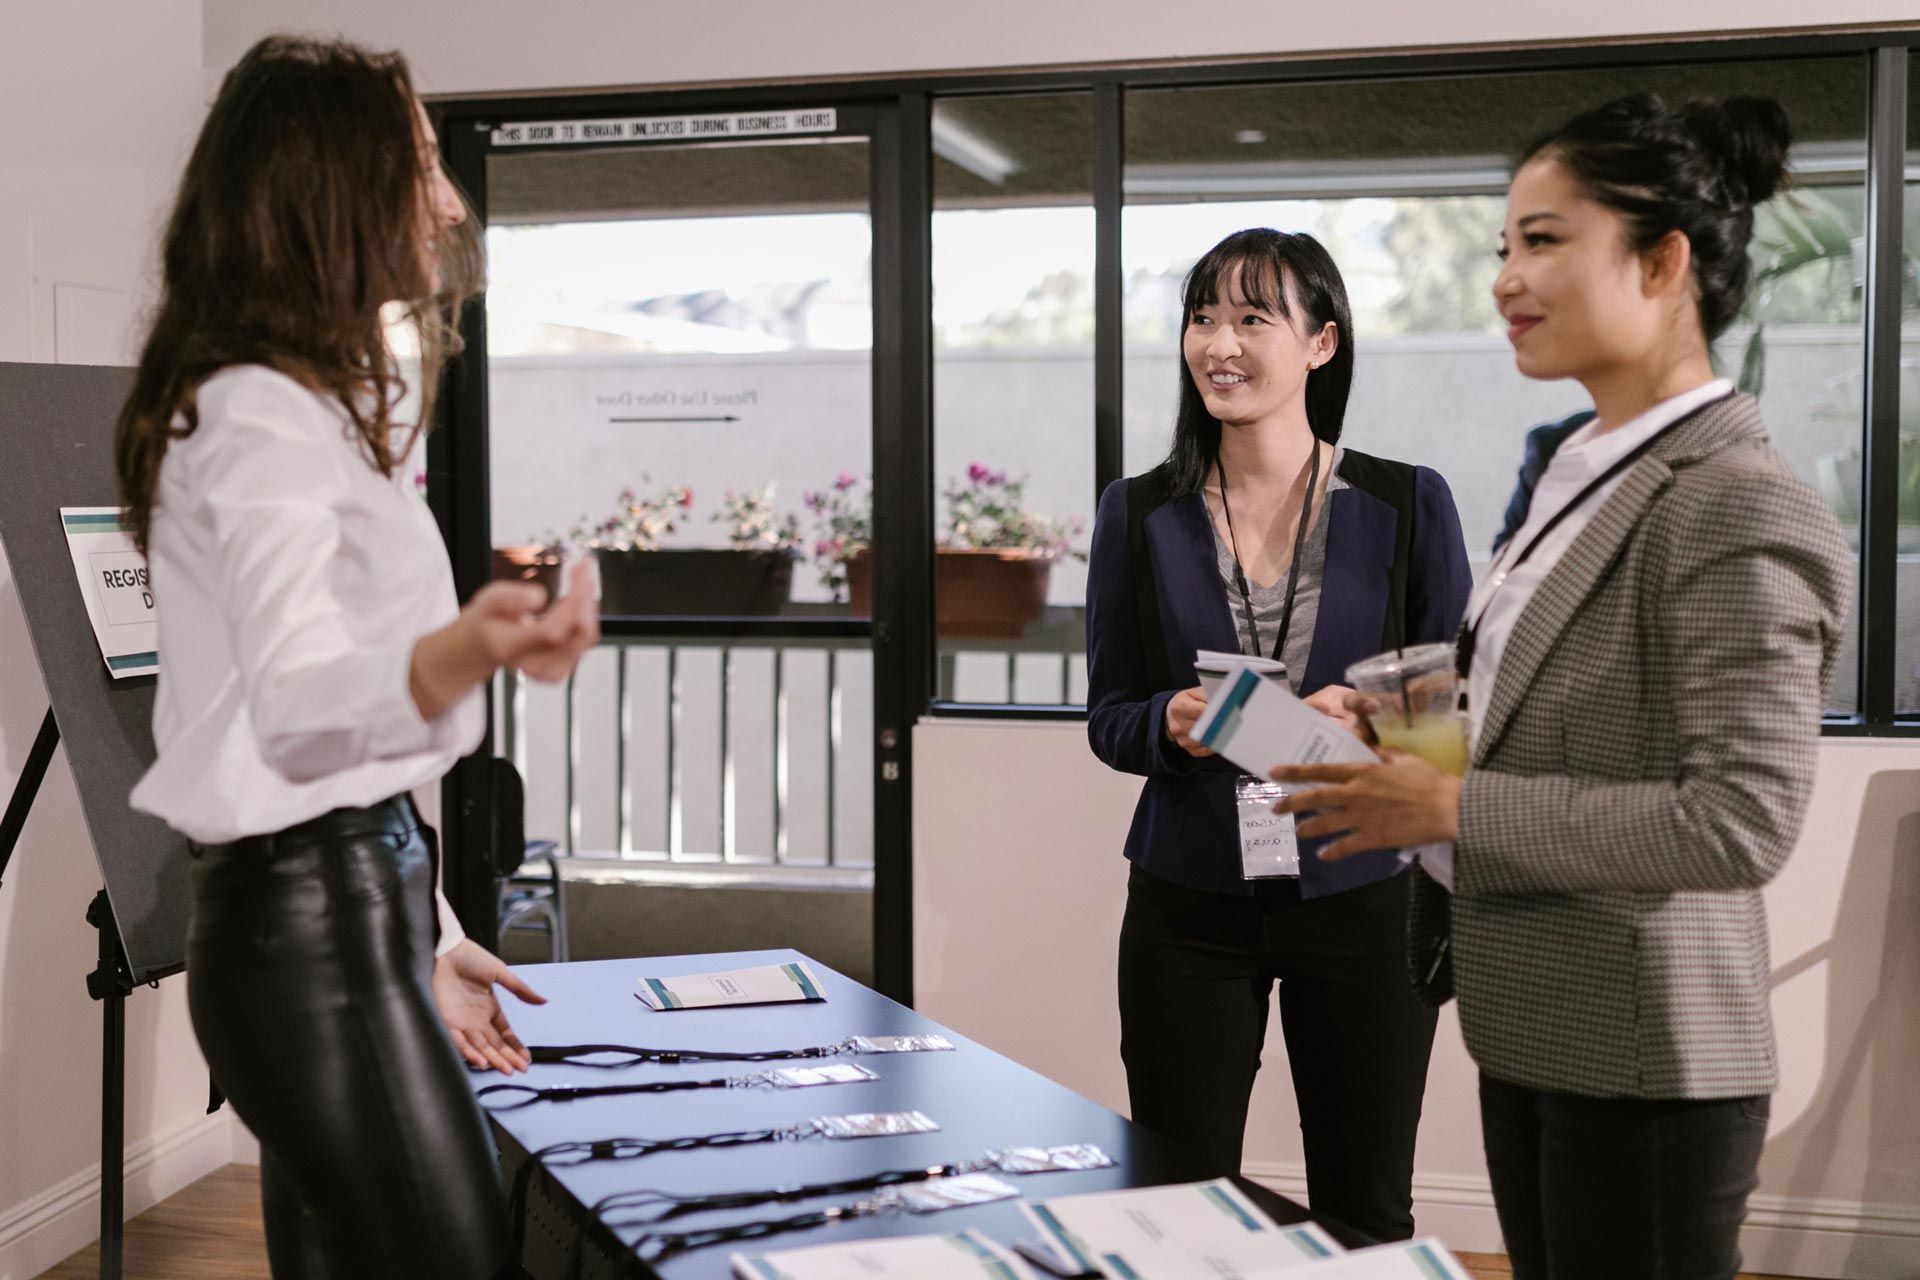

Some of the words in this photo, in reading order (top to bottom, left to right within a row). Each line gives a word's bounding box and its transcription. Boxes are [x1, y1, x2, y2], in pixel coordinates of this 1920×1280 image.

[691, 118, 729, 133] DURING
[738, 115, 787, 130] BUSINESS
[795, 113, 831, 127] HOURS
[103, 568, 149, 588] REGIS
[142, 592, 154, 609] D
